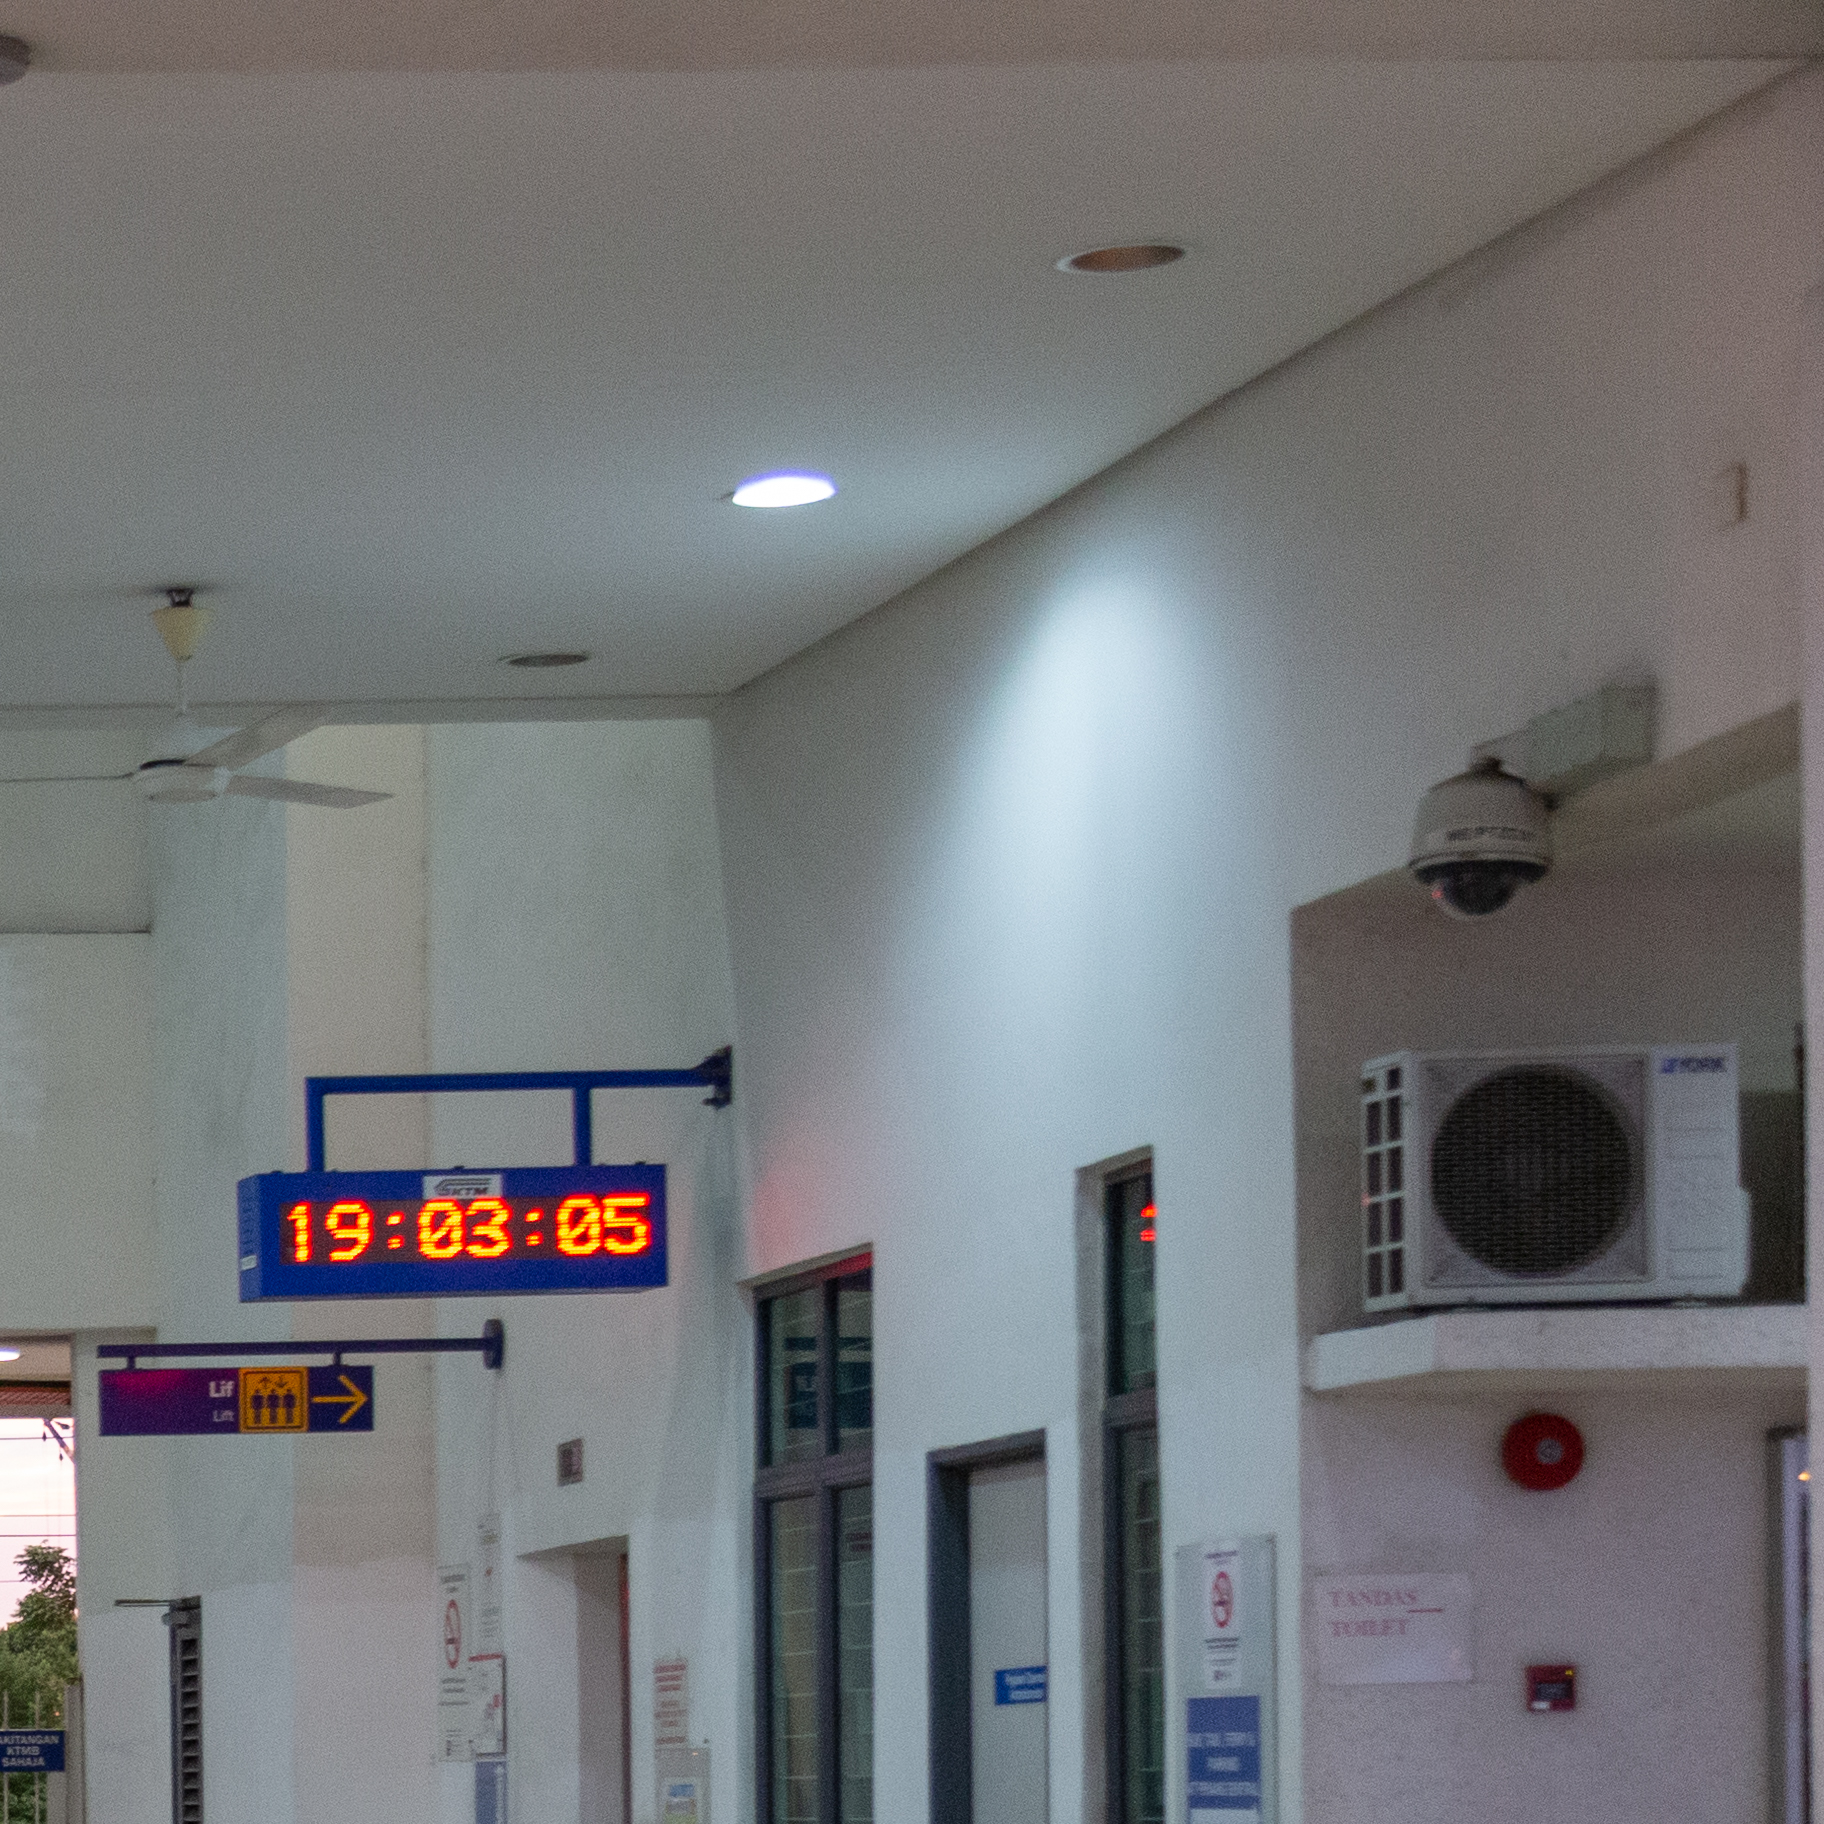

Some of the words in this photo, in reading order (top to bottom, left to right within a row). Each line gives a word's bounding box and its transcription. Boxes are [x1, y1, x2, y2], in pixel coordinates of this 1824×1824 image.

[287, 1192, 650, 1263] 19:03:05
[209, 1380, 235, 1398] Lif
[212, 1409, 235, 1422] Lift
[6, 1746, 40, 1756] KTMB
[2, 1756, 46, 1767] SAHAJA
